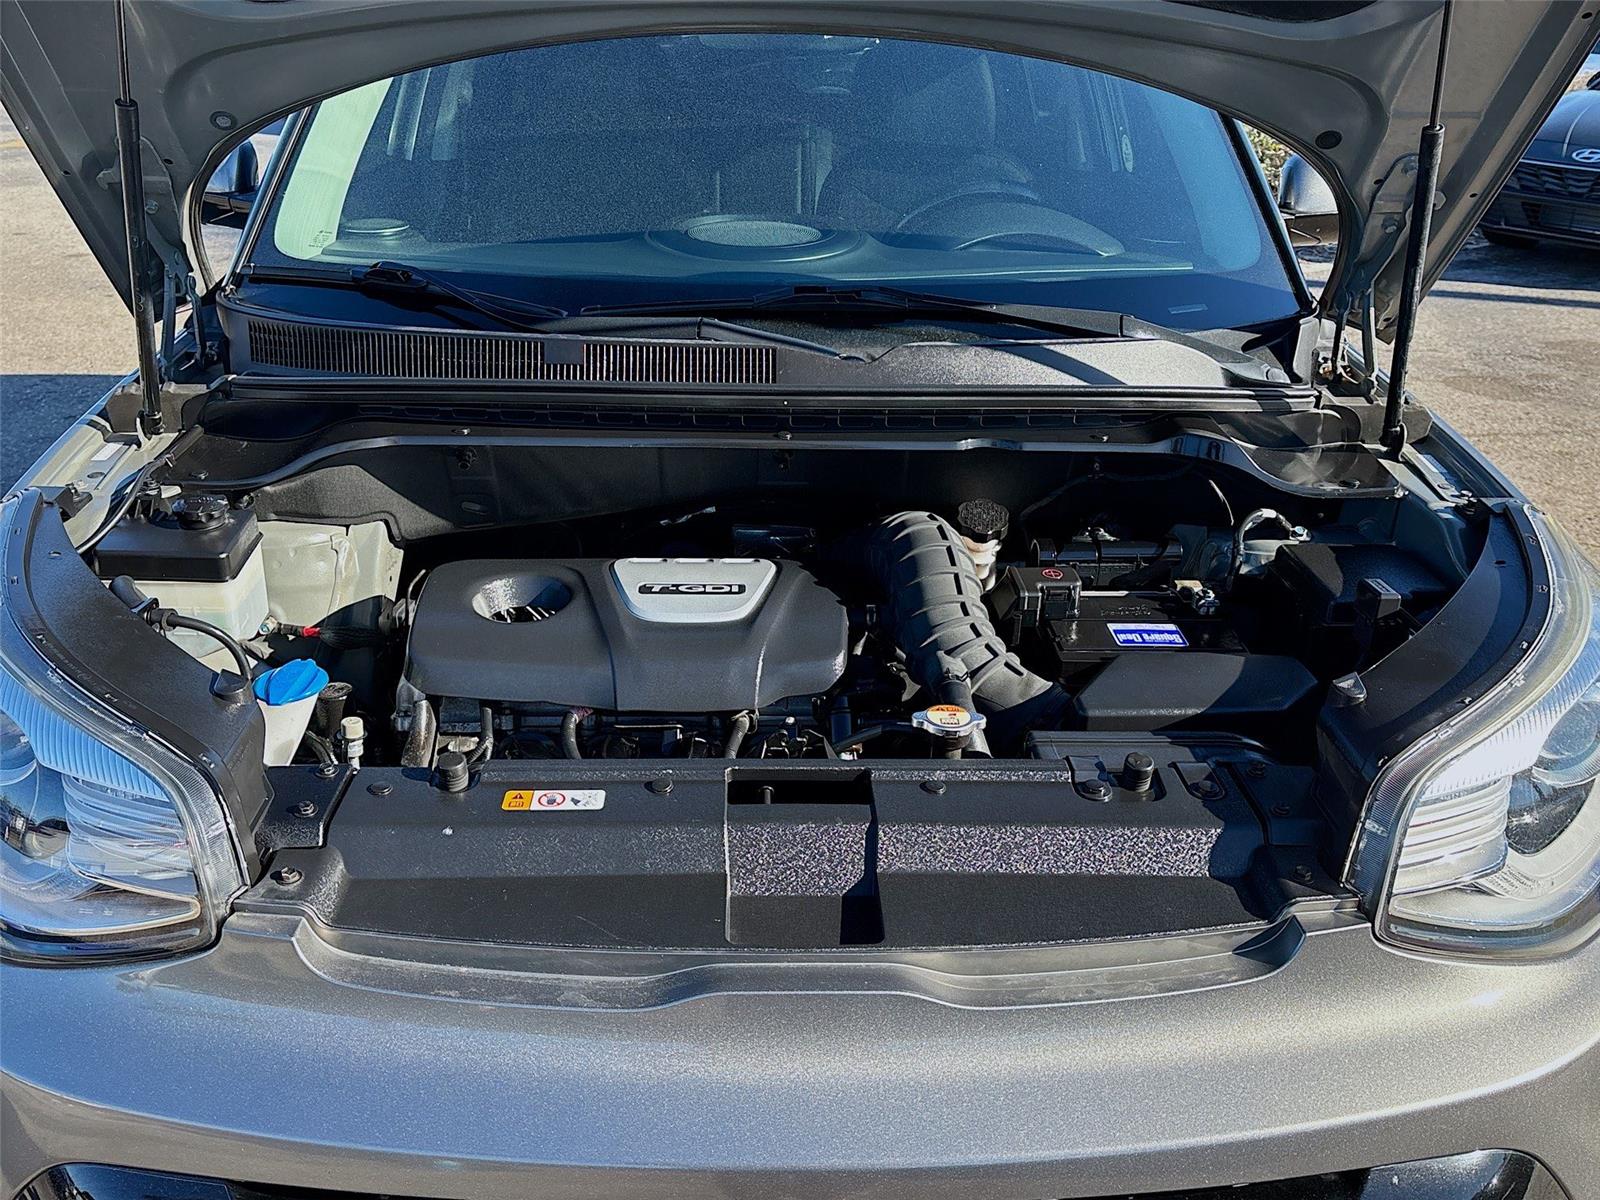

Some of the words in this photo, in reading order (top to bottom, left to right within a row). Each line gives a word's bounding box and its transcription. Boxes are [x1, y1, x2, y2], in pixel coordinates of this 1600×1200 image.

[645, 584, 739, 593] T-GDI
[1116, 633, 1143, 642] Deal
[1142, 633, 1183, 643] Square
